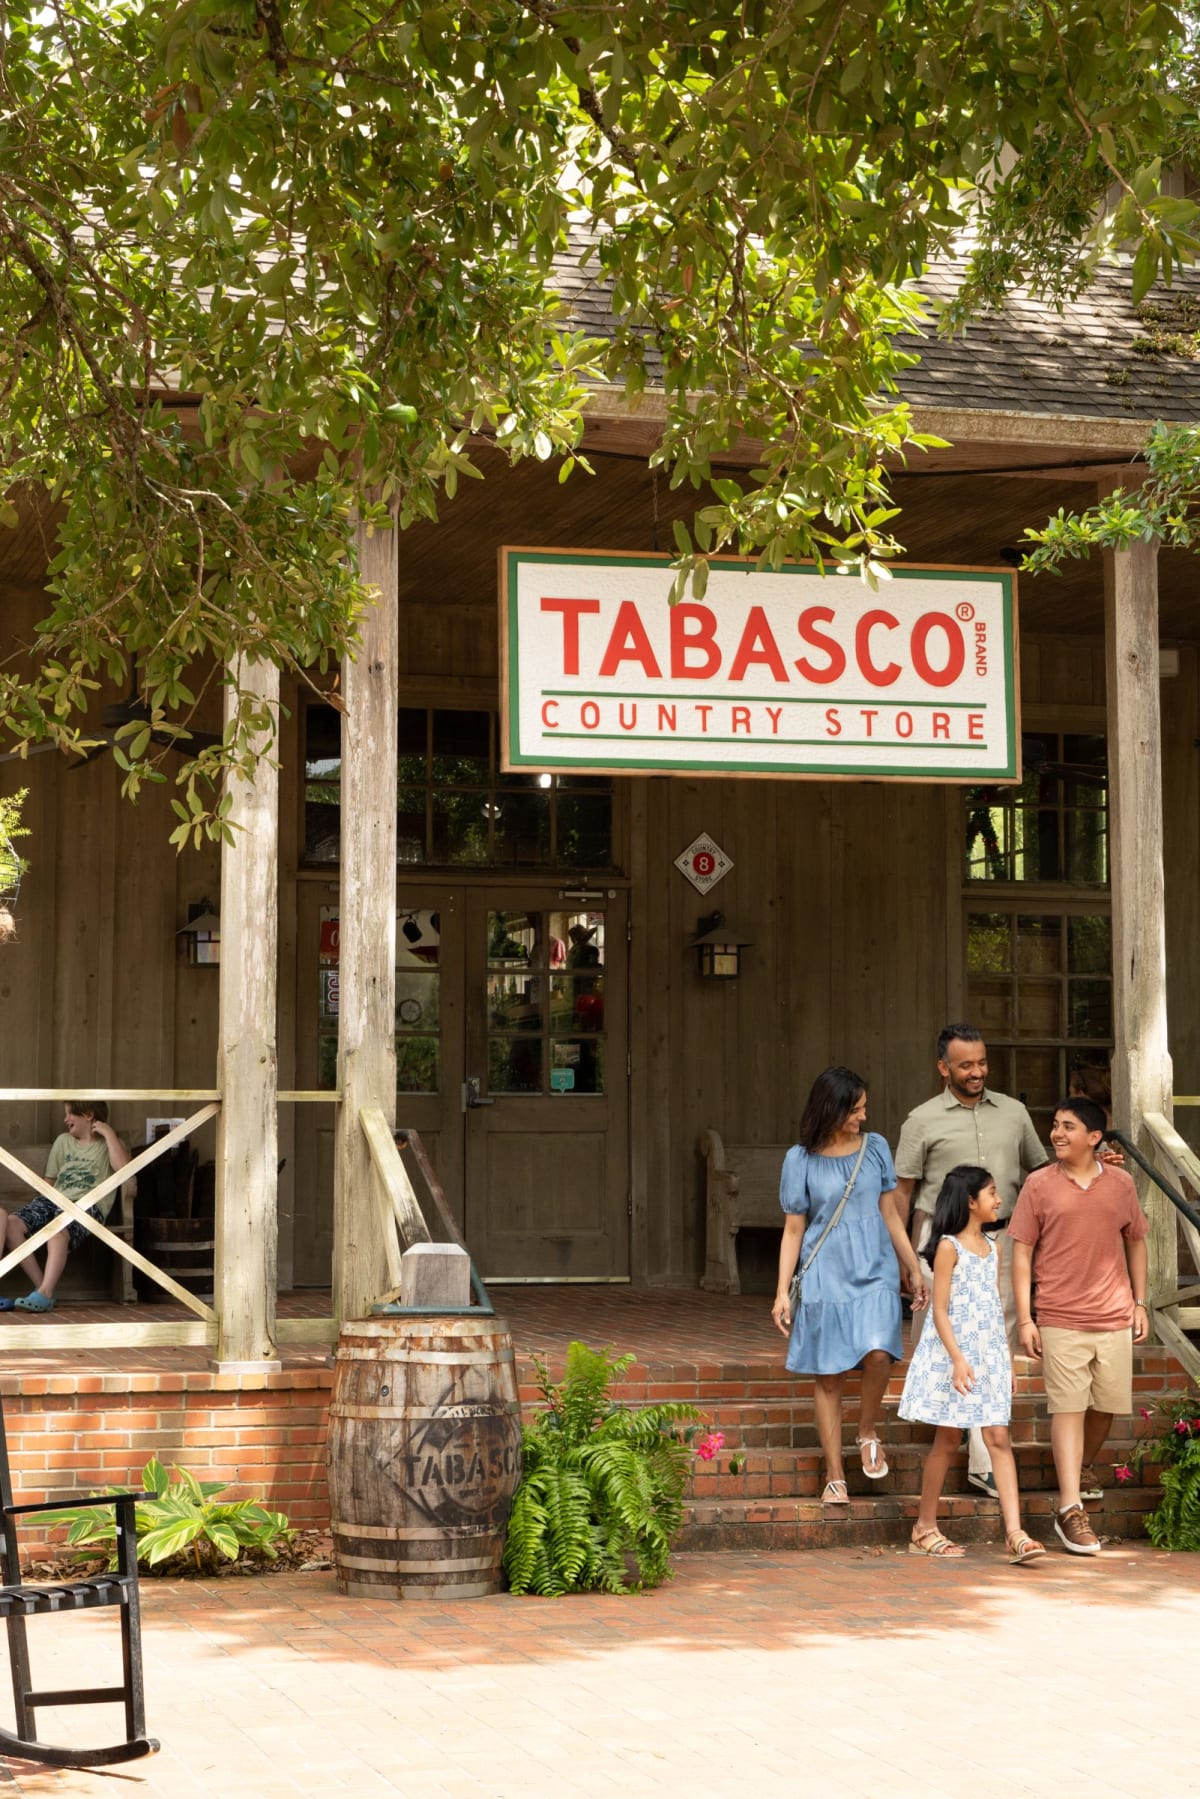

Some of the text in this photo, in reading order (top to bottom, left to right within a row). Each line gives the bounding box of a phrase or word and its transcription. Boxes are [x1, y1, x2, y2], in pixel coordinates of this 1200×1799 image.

[974, 621, 988, 677] BRAND
[540, 699, 984, 741] COUNTRY STORE
[699, 856, 709, 872] 8
[401, 1441, 523, 1488] TABASCO
